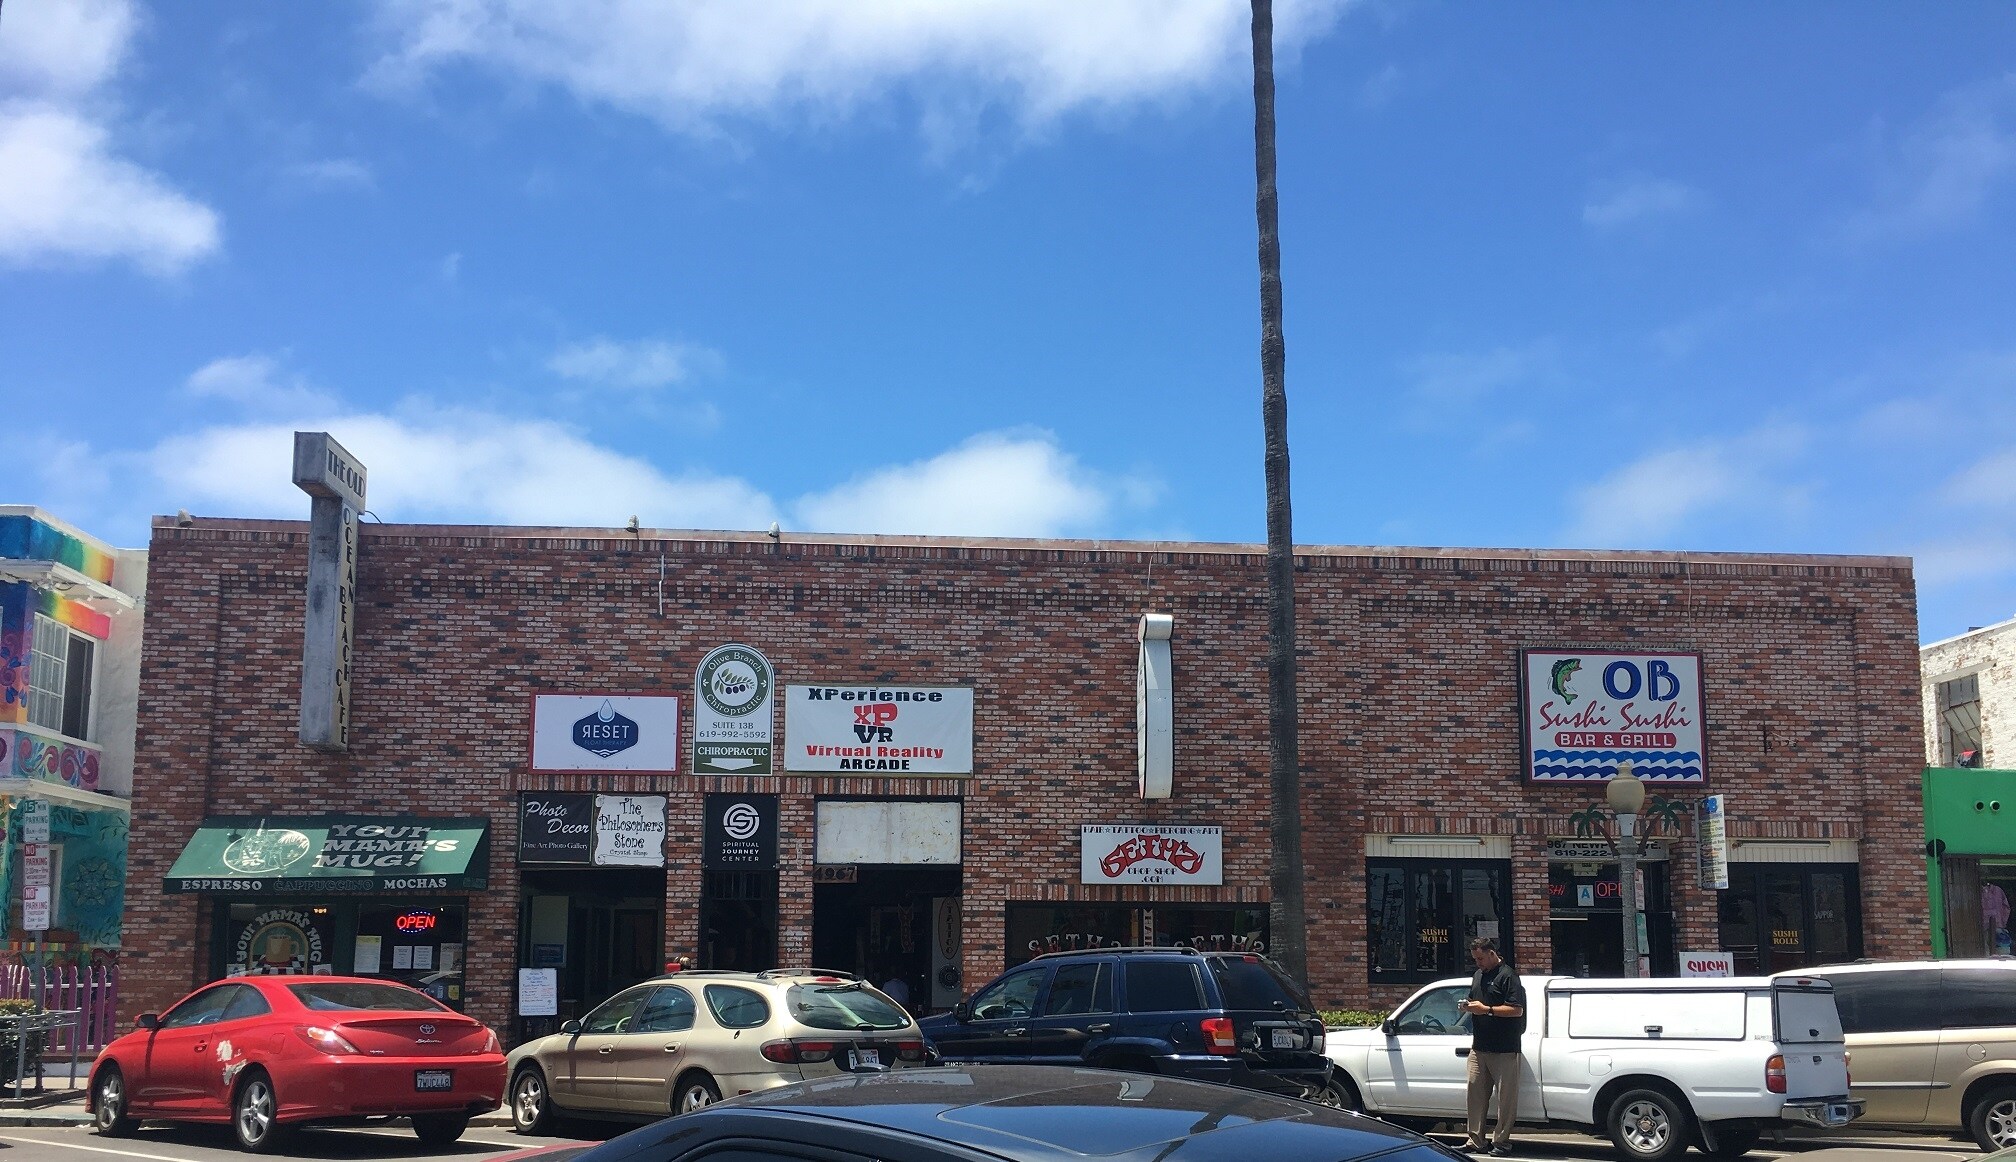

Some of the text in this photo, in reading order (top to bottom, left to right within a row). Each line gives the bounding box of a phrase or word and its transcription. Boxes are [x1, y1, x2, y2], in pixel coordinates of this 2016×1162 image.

[327, 448, 366, 498] THE OLD
[343, 507, 355, 604] OCEAN
[339, 585, 350, 682] BEACH
[708, 651, 763, 673] Olive Branch
[1602, 659, 1681, 702] OB
[808, 687, 943, 702] XPerience
[335, 668, 347, 744] CAFE
[706, 694, 762, 716] Chiropractic
[853, 702, 898, 727] XP
[1539, 700, 1692, 731] Sushi Sushi
[712, 721, 736, 729] SUITE
[699, 730, 767, 738] 619-992-5592
[853, 725, 894, 744] VR
[1560, 733, 1672, 747] BAR & GRILL
[697, 746, 768, 756] CHIROPRACTIC
[807, 745, 944, 759] Virtual Reality
[840, 758, 910, 770] ARCADE
[25, 802, 35, 812] 15
[525, 801, 568, 822] Photo
[619, 798, 642, 815] The
[26, 815, 48, 824] PARKING
[547, 818, 590, 834] Decor
[1083, 826, 1220, 835] HAIR TATTOO PIERCING ART
[321, 839, 459, 852] MAMA'S
[567, 842, 588, 850] Gallery
[614, 832, 645, 849] Stone
[25, 845, 35, 855] NO
[26, 857, 48, 866] PARKING
[312, 854, 424, 868] MUG!
[817, 866, 856, 880] 4967
[1141, 875, 1164, 883] .COM
[181, 878, 448, 892] ESPRESSO CAPPUCCINO MOCHAS
[25, 889, 35, 898] NO
[1581, 888, 1591, 899] A
[26, 901, 48, 910] PARKING
[397, 915, 436, 929] OPEN
[255, 908, 311, 931] MAMA'S
[306, 927, 323, 963] MUG
[1422, 928, 1448, 936] SUSHI
[1773, 930, 1798, 938] SUSHI
